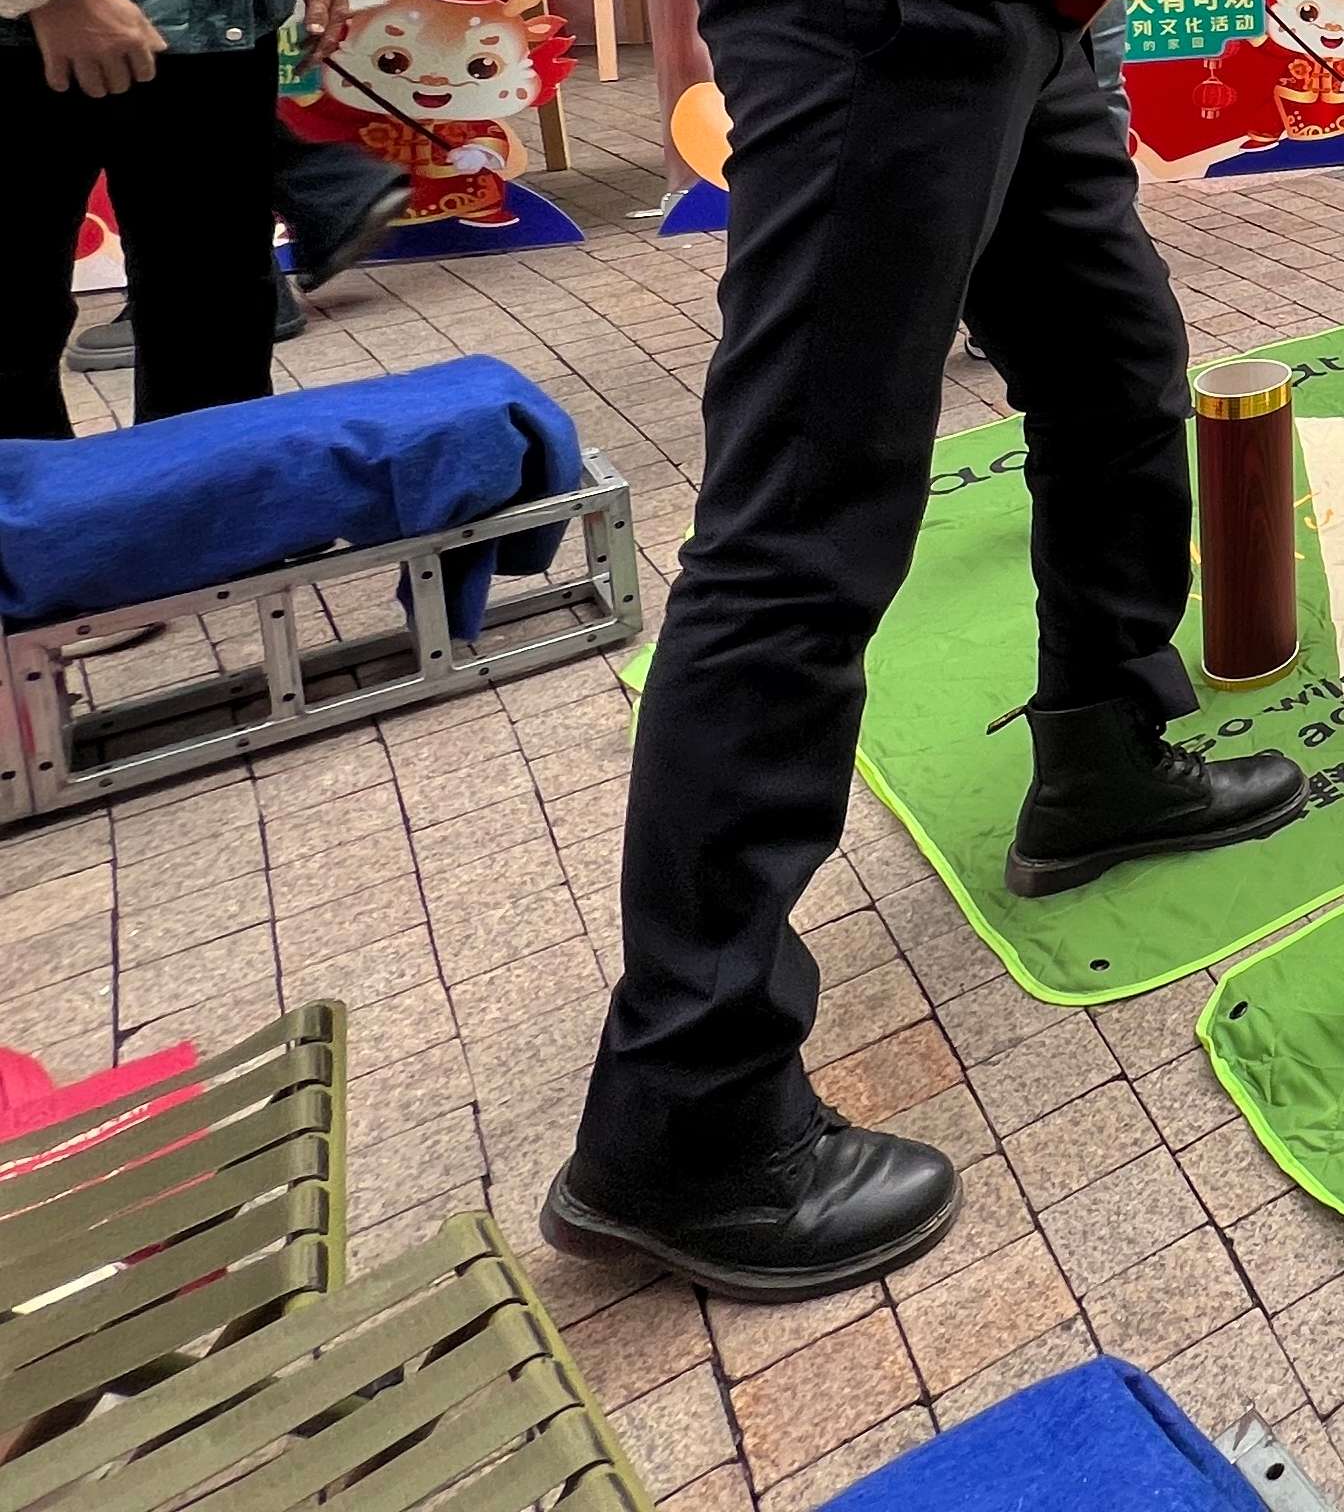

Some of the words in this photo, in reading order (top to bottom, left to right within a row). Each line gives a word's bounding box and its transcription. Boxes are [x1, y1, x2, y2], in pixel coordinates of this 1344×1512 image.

[1132, 14, 1255, 38] 列文化活动
